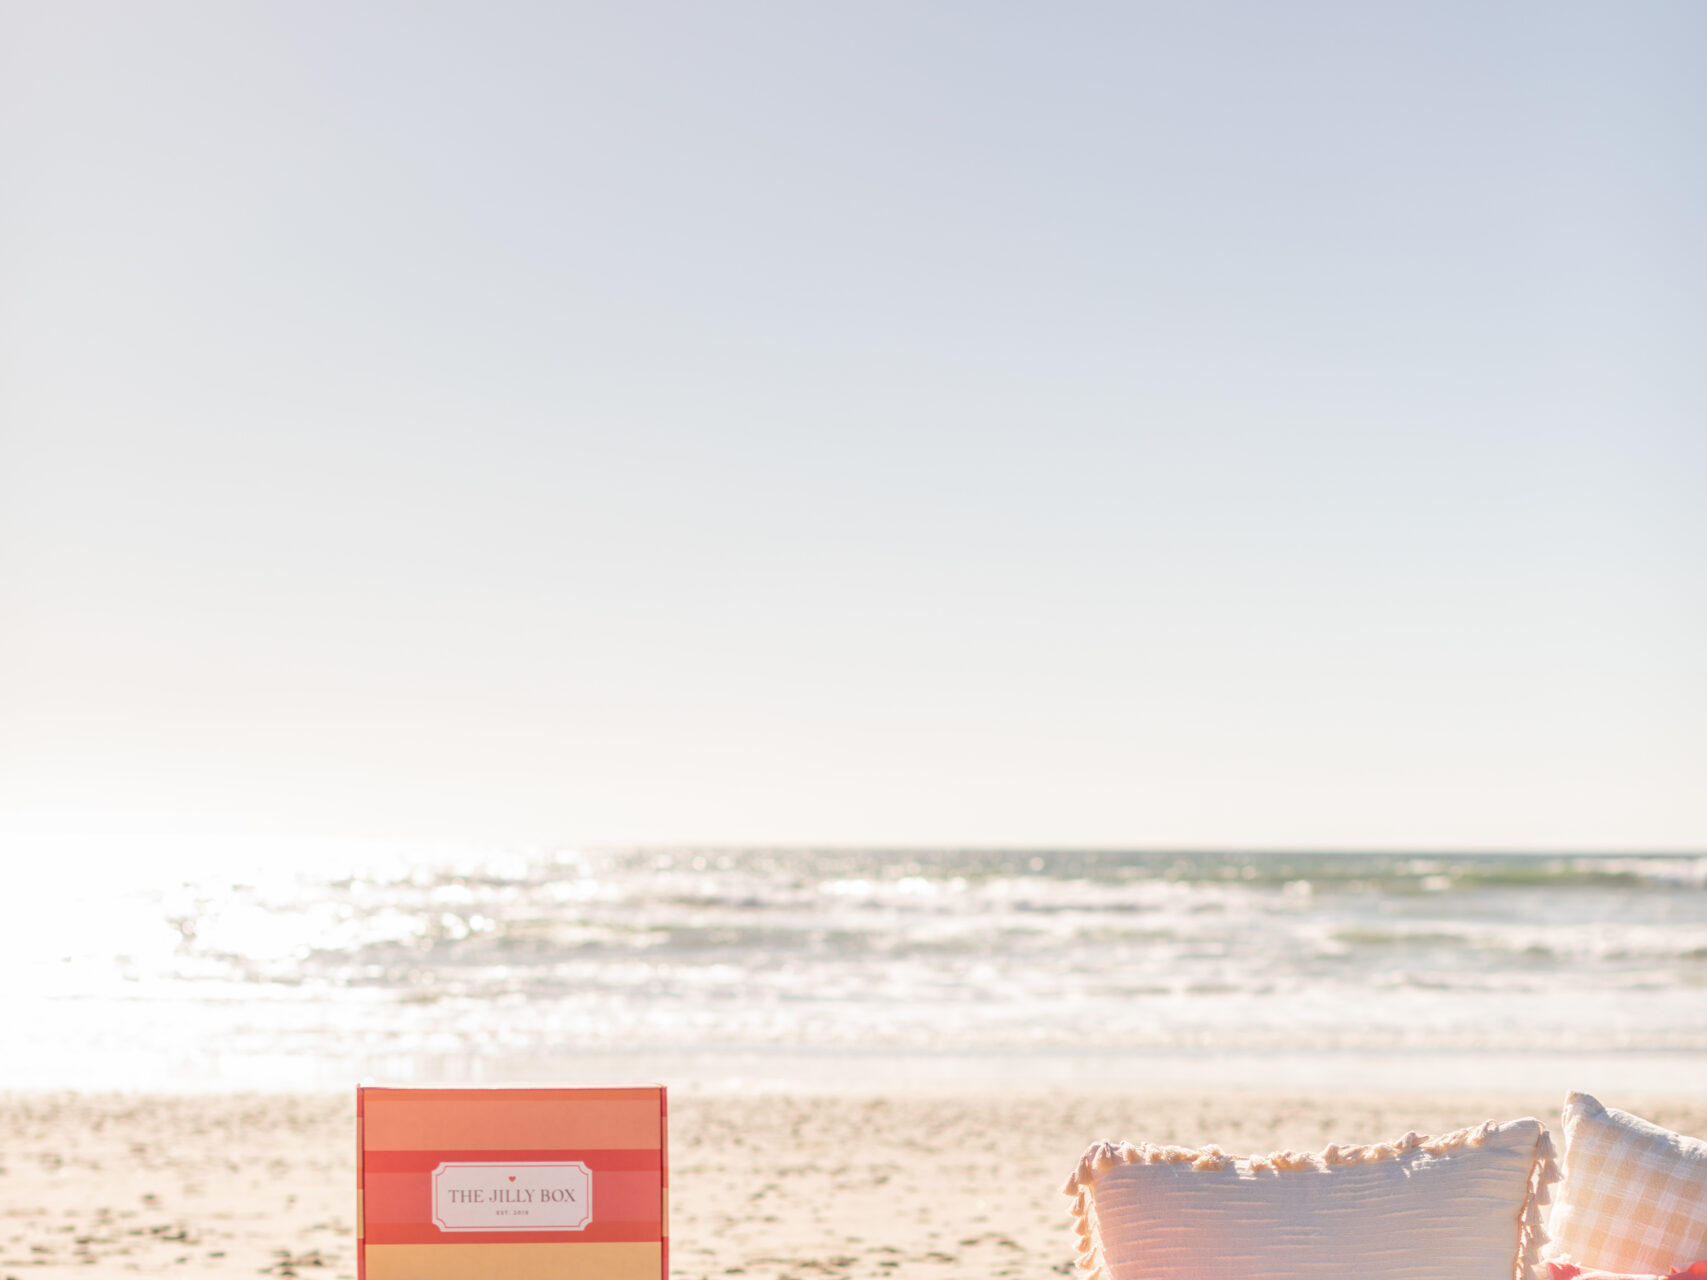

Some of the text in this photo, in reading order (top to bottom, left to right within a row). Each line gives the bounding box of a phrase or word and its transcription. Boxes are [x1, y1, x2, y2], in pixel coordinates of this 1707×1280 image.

[448, 1188, 576, 1203] THE JILLY BOX
